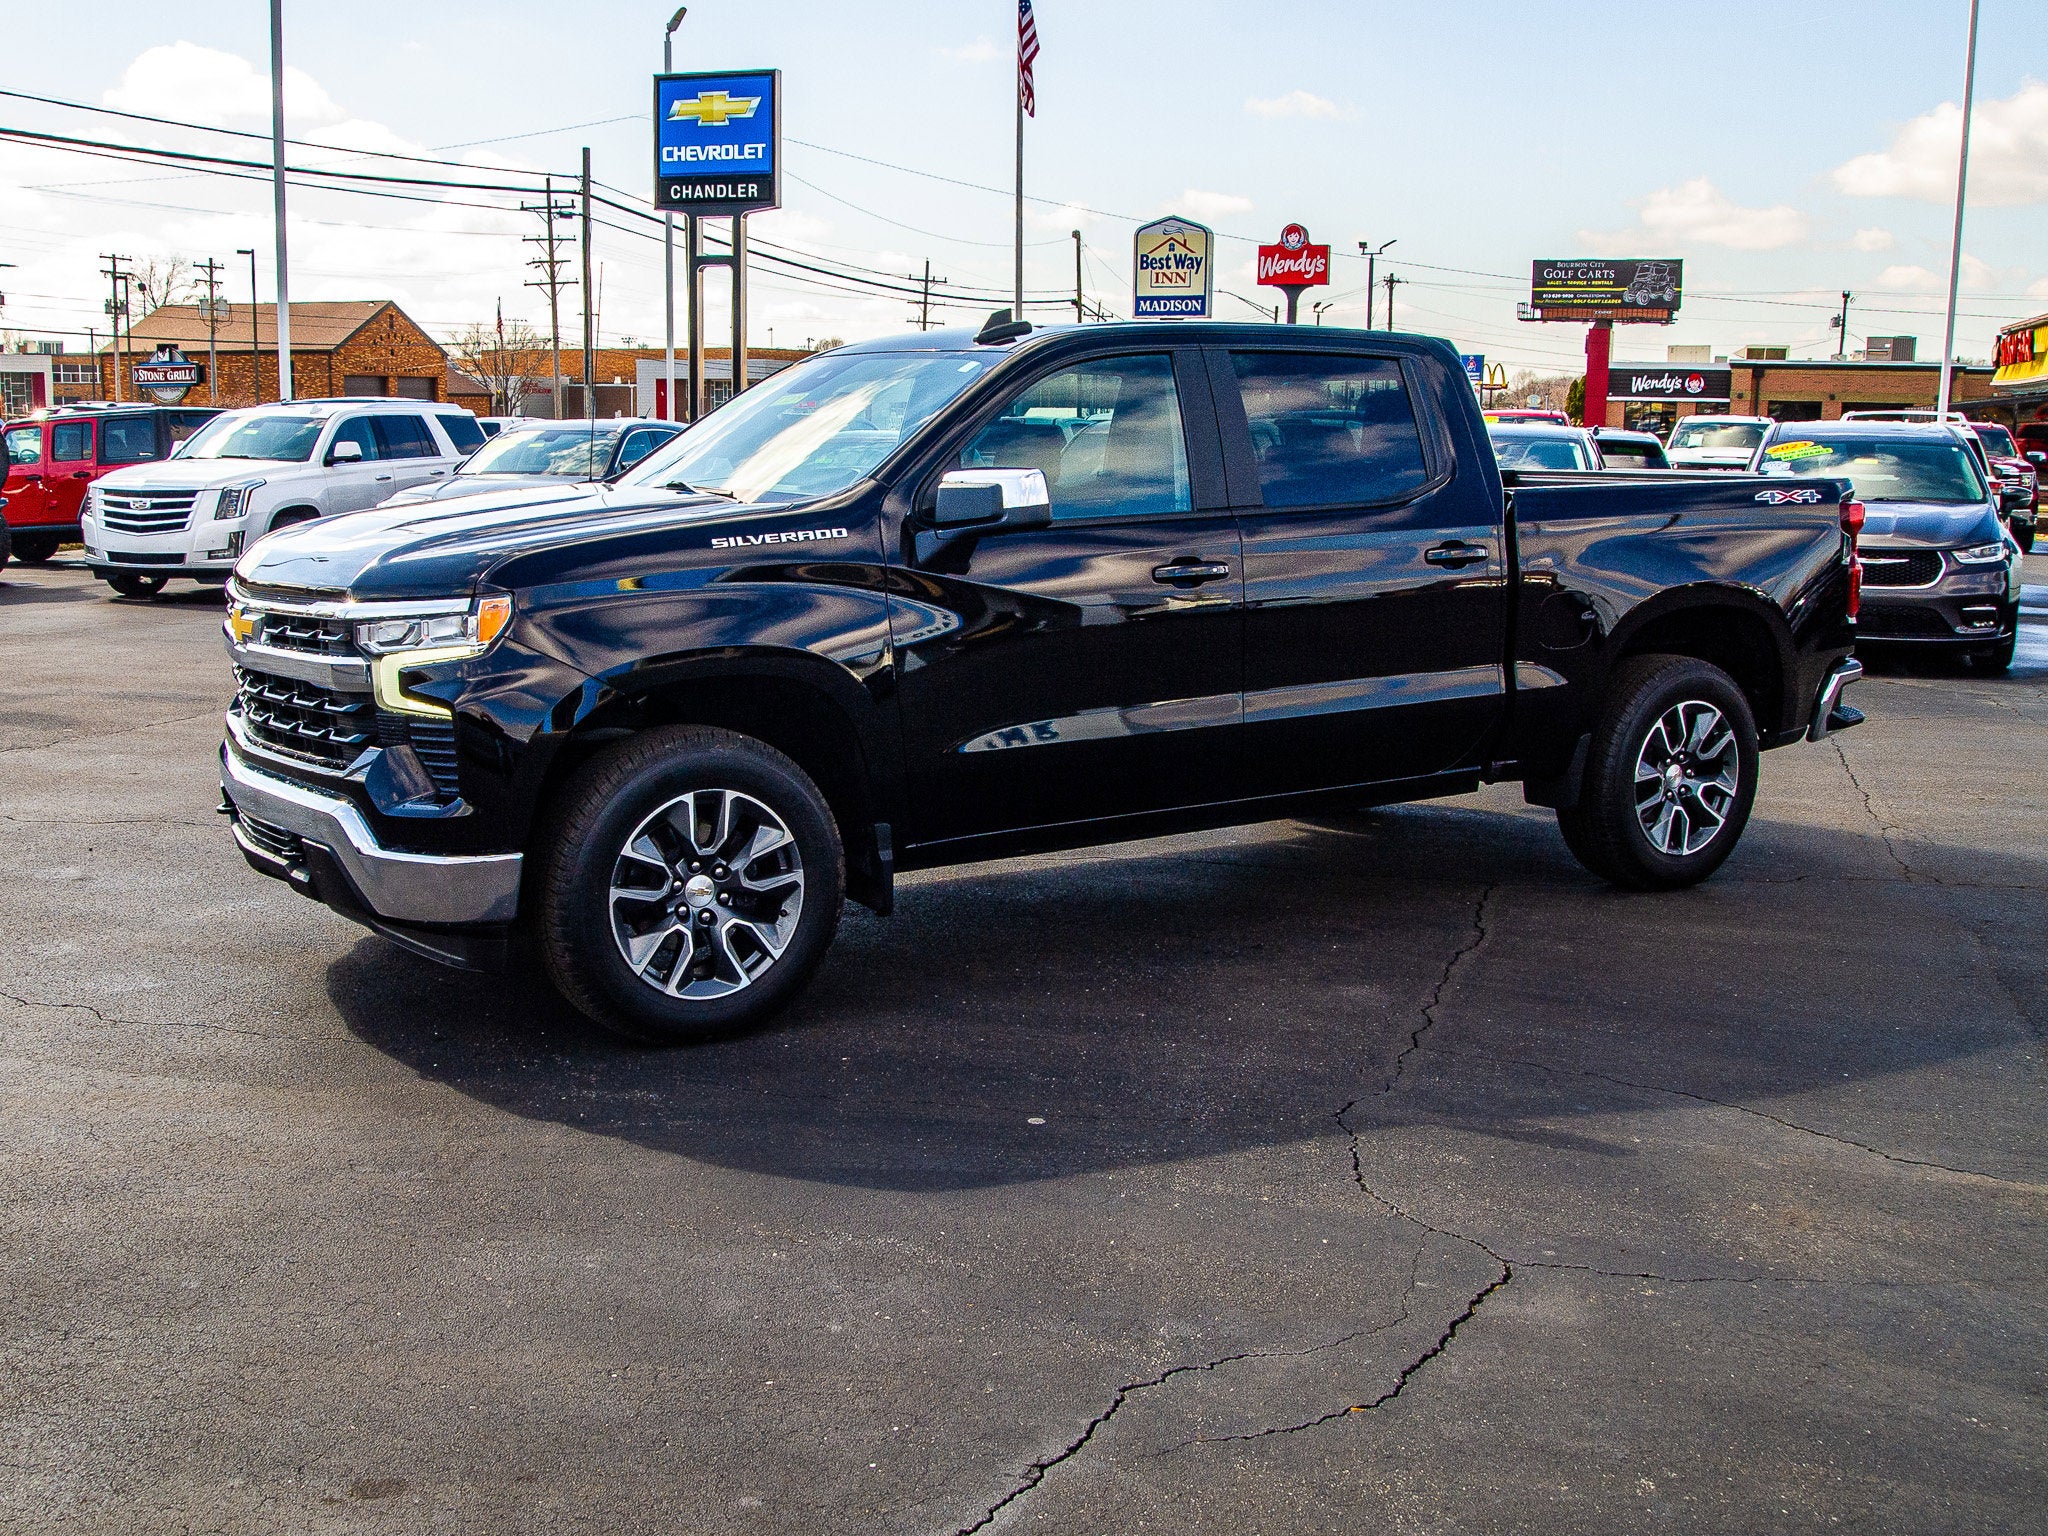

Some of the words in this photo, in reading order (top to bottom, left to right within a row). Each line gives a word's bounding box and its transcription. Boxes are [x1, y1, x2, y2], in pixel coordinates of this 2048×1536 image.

[662, 143, 766, 162] CHEVROLET
[670, 184, 758, 199] CHANDLER
[1140, 254, 1171, 271] Best
[1173, 253, 1203, 275] Way
[1259, 250, 1325, 279] Wendy's
[1154, 272, 1187, 284] INN
[1543, 268, 1574, 279] GOLF
[1578, 268, 1615, 279] CARTS
[1138, 299, 1202, 312] MADISON
[138, 369, 165, 381] STONE
[166, 369, 191, 380] GRILL
[1631, 372, 1682, 393] Wendy's
[711, 527, 848, 549] SILVERADO
